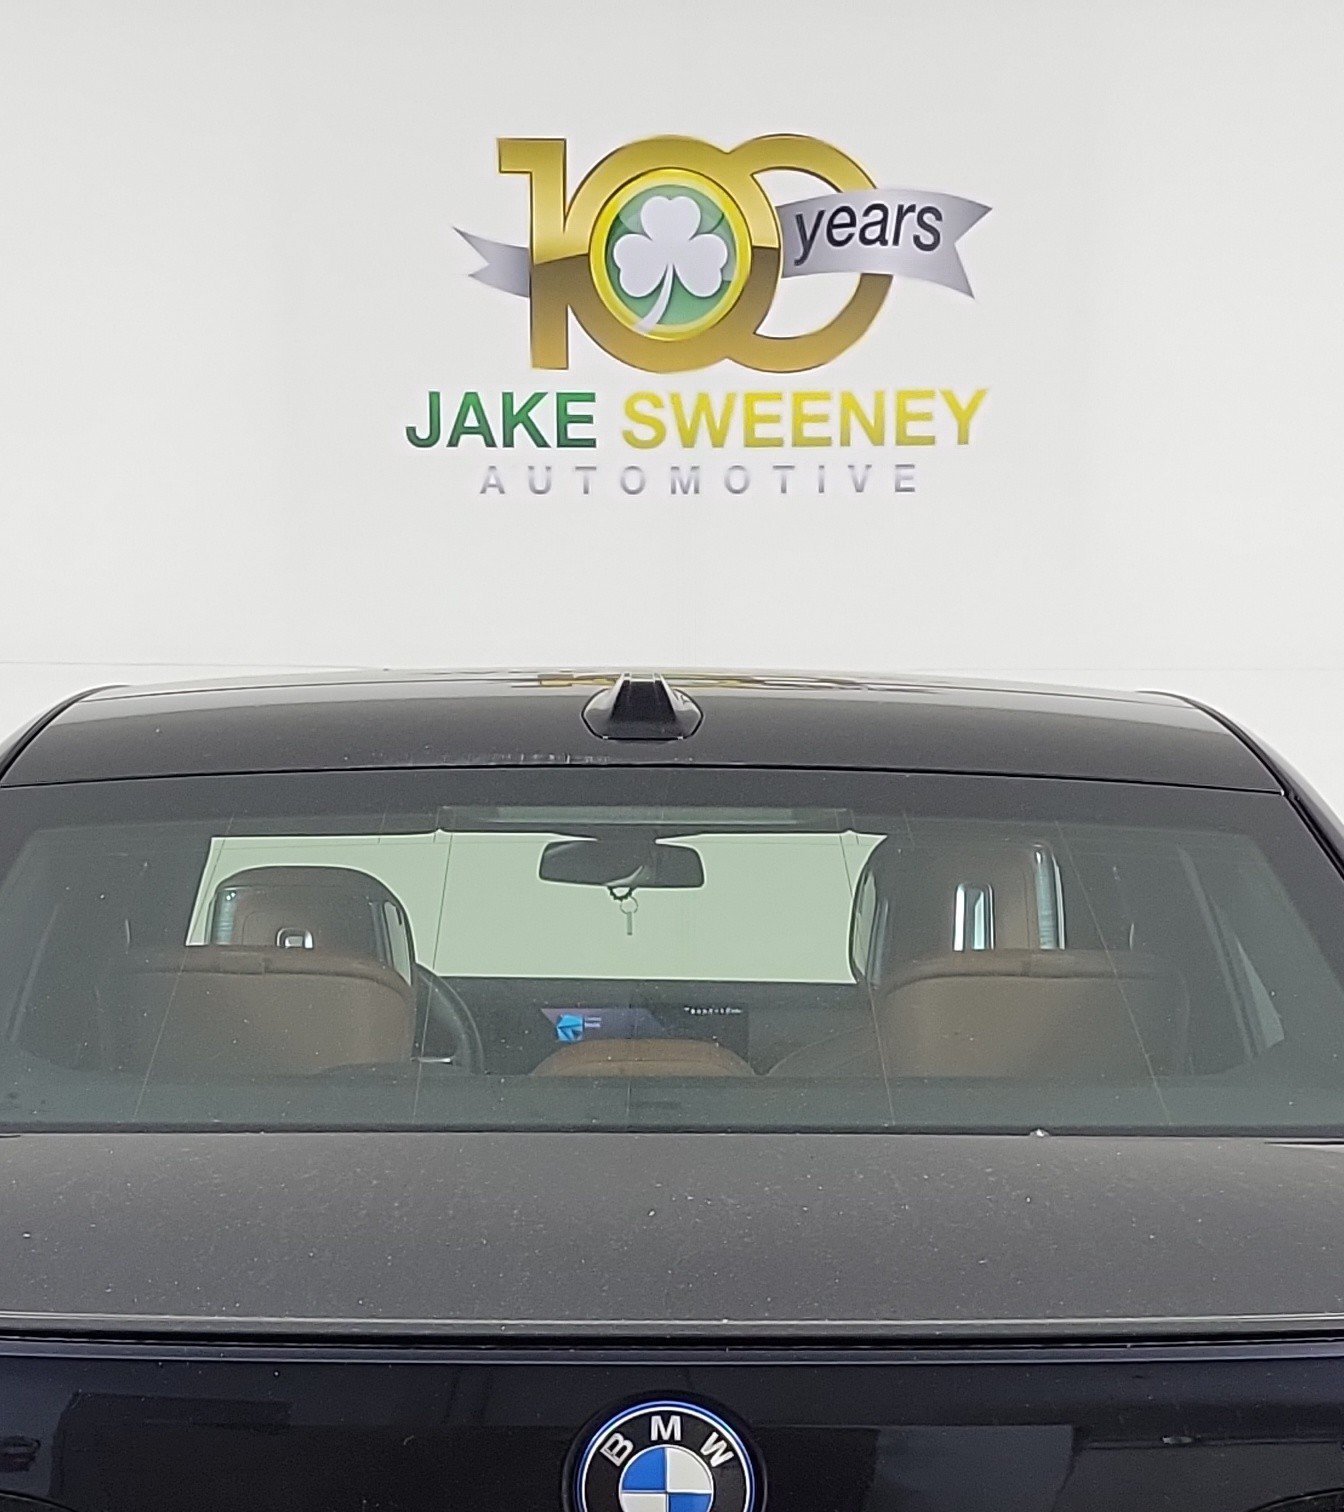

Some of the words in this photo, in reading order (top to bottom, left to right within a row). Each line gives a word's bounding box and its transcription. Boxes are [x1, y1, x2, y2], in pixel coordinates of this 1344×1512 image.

[793, 202, 944, 266] years
[405, 391, 597, 449] JAKE
[621, 389, 988, 450] SWEENEY
[480, 464, 917, 496] AUTOMOTIVE
[599, 1415, 735, 1467] BMW
